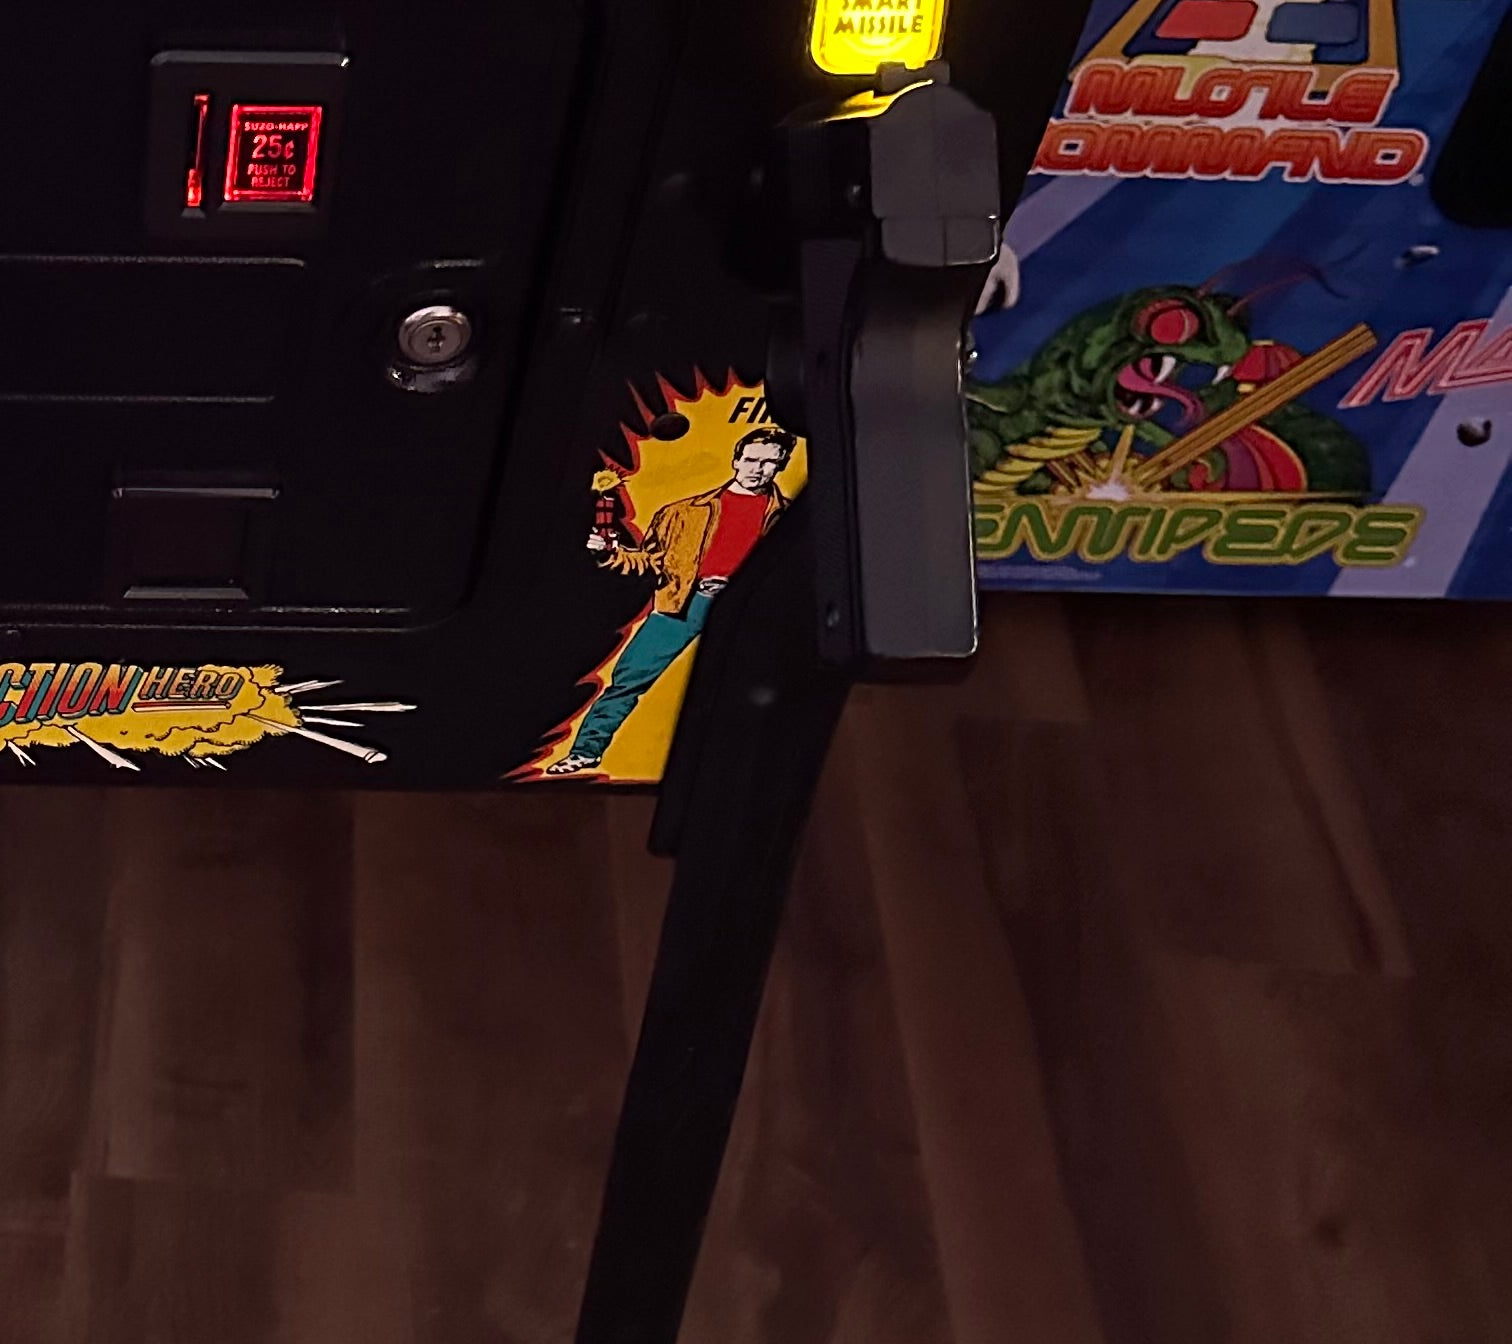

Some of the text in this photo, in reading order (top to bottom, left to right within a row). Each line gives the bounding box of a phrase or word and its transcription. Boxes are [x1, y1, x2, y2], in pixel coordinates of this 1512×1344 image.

[833, 14, 924, 35] MISSILE
[251, 134, 295, 160] 25¢
[247, 163, 296, 176] PUSH TO
[251, 176, 291, 188] REJECT
[138, 665, 246, 701] HERO
